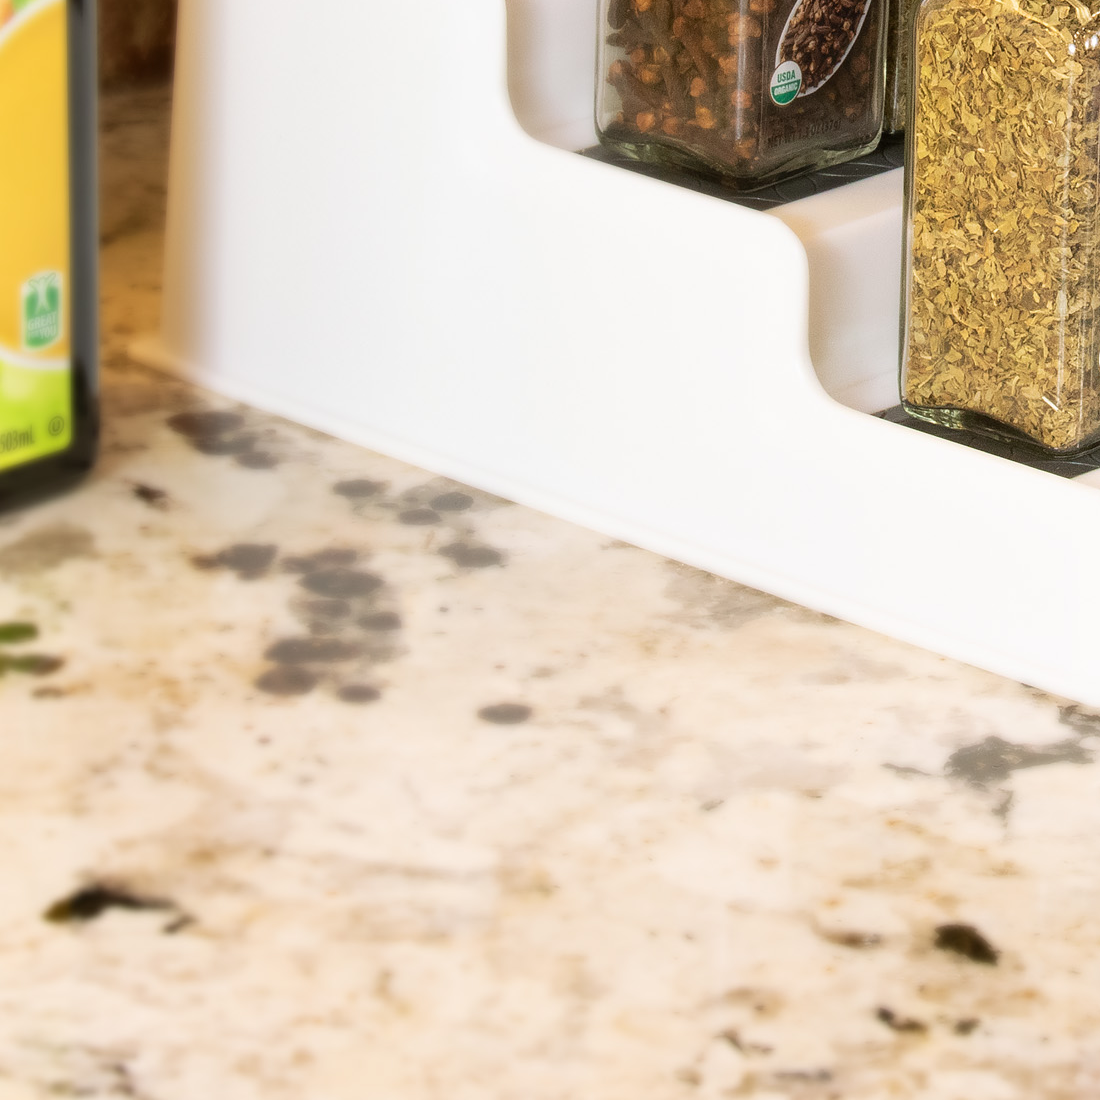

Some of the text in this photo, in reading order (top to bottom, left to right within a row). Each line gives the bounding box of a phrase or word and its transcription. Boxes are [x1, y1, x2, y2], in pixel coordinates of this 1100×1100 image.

[778, 70, 795, 82] USDA
[774, 82, 798, 96] ORGANIC
[28, 311, 56, 331] GREAT
[39, 324, 56, 339] YOU
